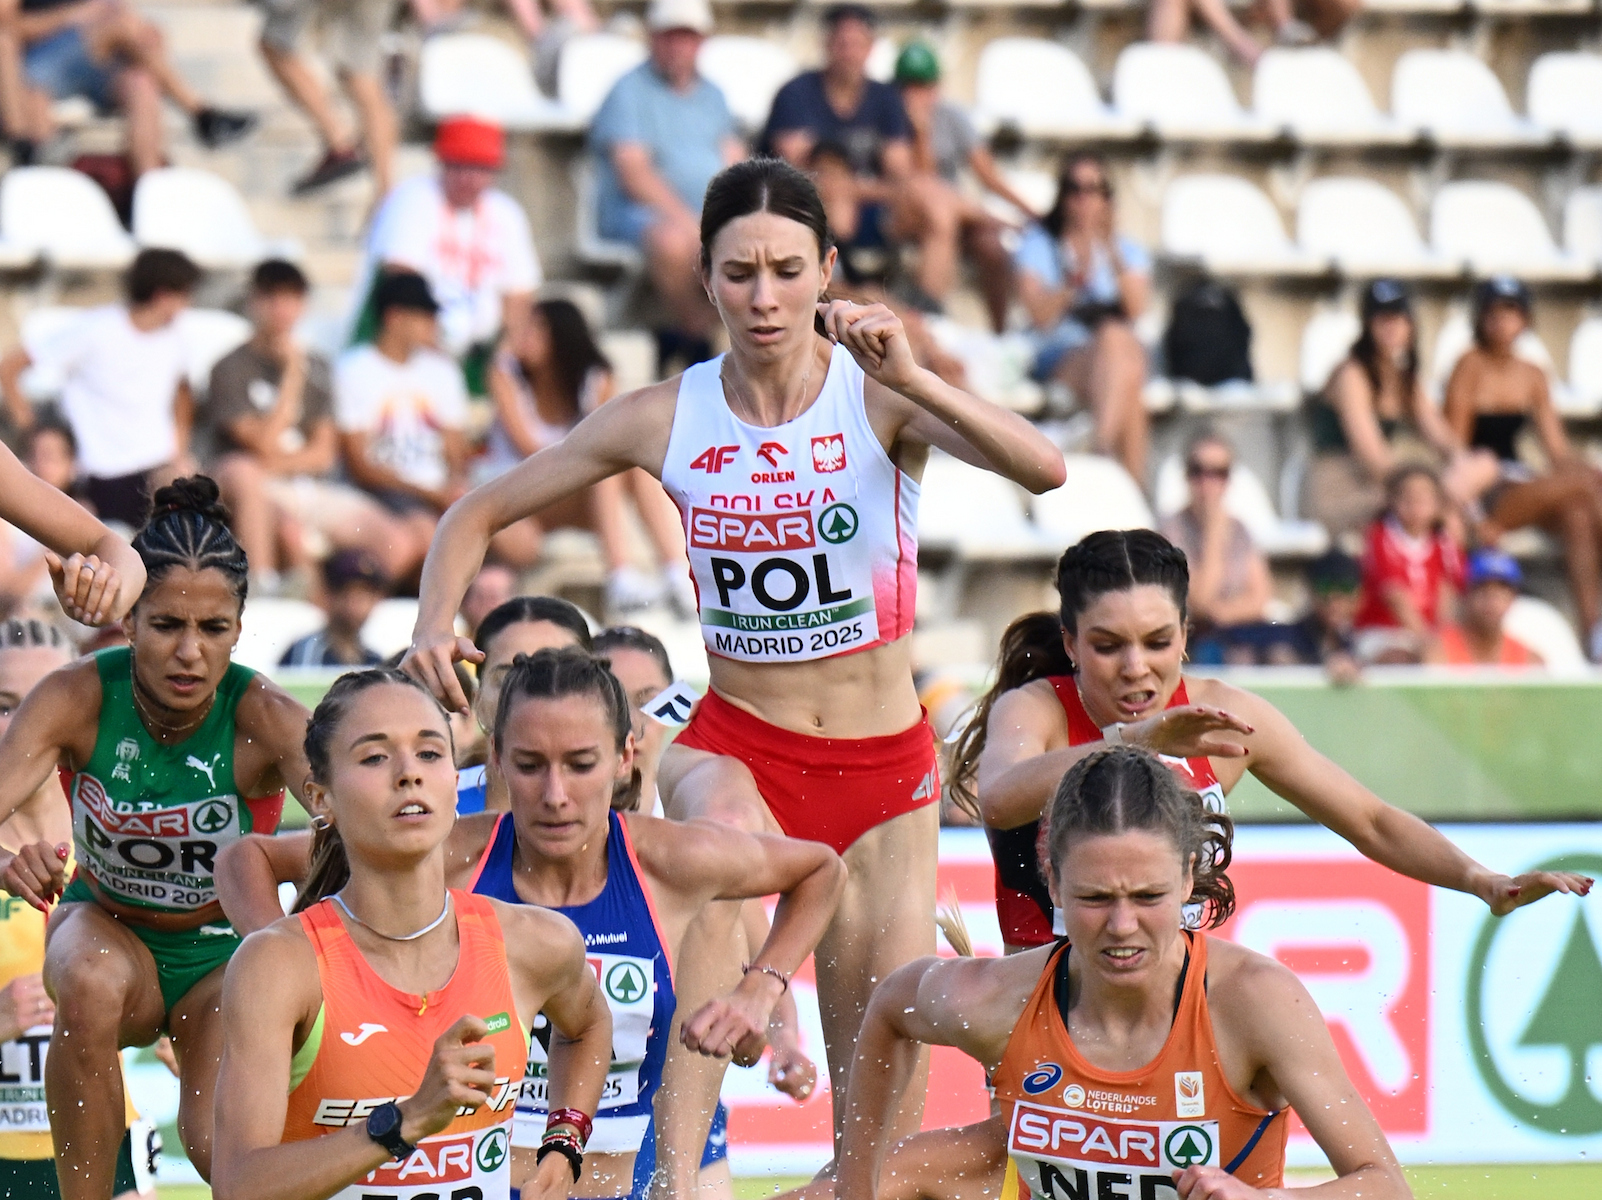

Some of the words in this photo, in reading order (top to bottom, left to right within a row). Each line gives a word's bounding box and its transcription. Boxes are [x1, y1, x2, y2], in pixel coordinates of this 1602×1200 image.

[751, 471, 796, 484] ORLEN
[693, 515, 813, 547] SPAR
[710, 553, 852, 611] POL
[715, 632, 804, 656] MADRID
[810, 621, 863, 652] 2025
[739, 616, 772, 630] RUN
[85, 815, 218, 874] POR
[596, 931, 627, 945] Mutuel
[0, 1035, 51, 1082] LT
[1086, 1098, 1132, 1113] LOTERIJ
[1087, 1089, 1157, 1106] NEDERLANDSE
[1017, 1113, 1156, 1162] SPAR
